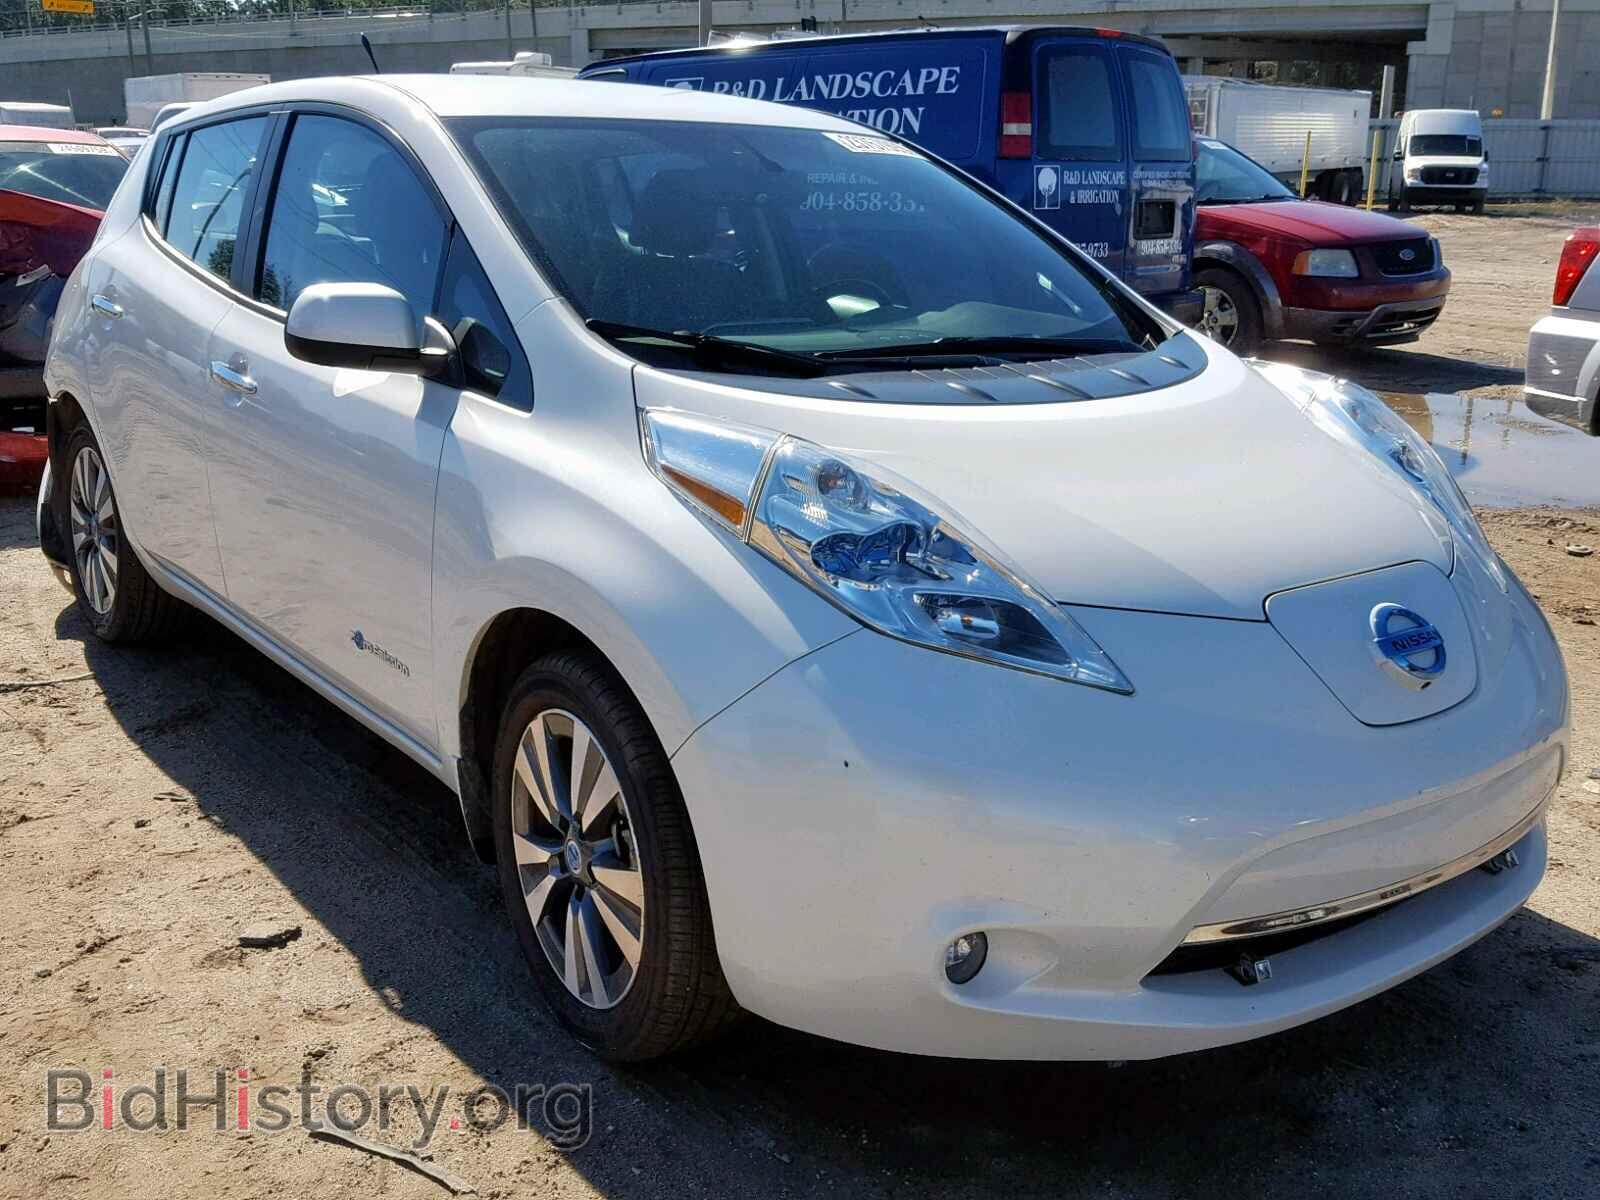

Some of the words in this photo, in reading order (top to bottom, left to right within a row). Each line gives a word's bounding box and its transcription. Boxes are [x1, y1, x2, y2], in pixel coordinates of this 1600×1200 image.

[714, 79, 767, 99] R&D
[772, 66, 961, 102] LANDSCAPE
[1063, 170, 1080, 185] R&D
[1082, 170, 1126, 185] LANDSCAPE
[1069, 190, 1076, 204] &
[1077, 189, 1120, 204] IRRIGATION
